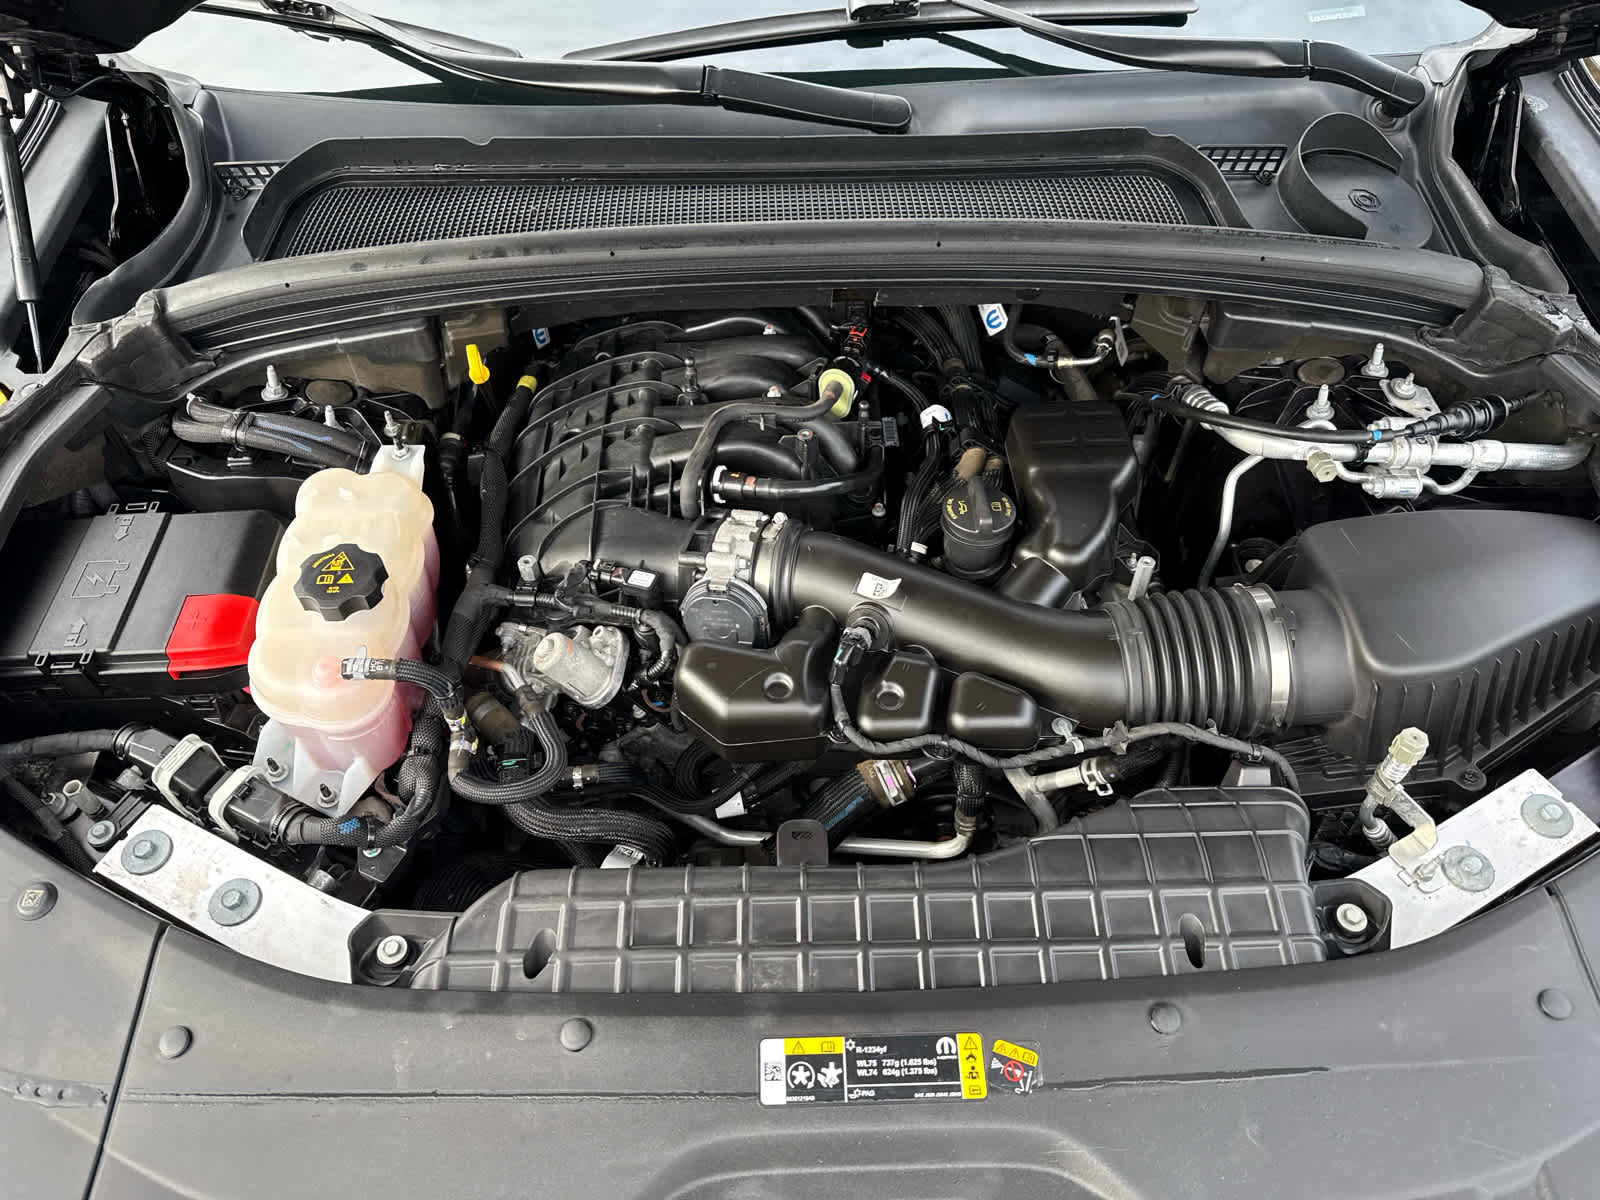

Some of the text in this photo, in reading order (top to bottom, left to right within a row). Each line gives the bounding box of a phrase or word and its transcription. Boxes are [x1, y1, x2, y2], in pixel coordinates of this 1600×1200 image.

[881, 1059, 900, 1068] 737g
[923, 1057, 937, 1067] lbs)
[857, 1069, 878, 1077] WL74
[923, 1067, 938, 1076] lbs)
